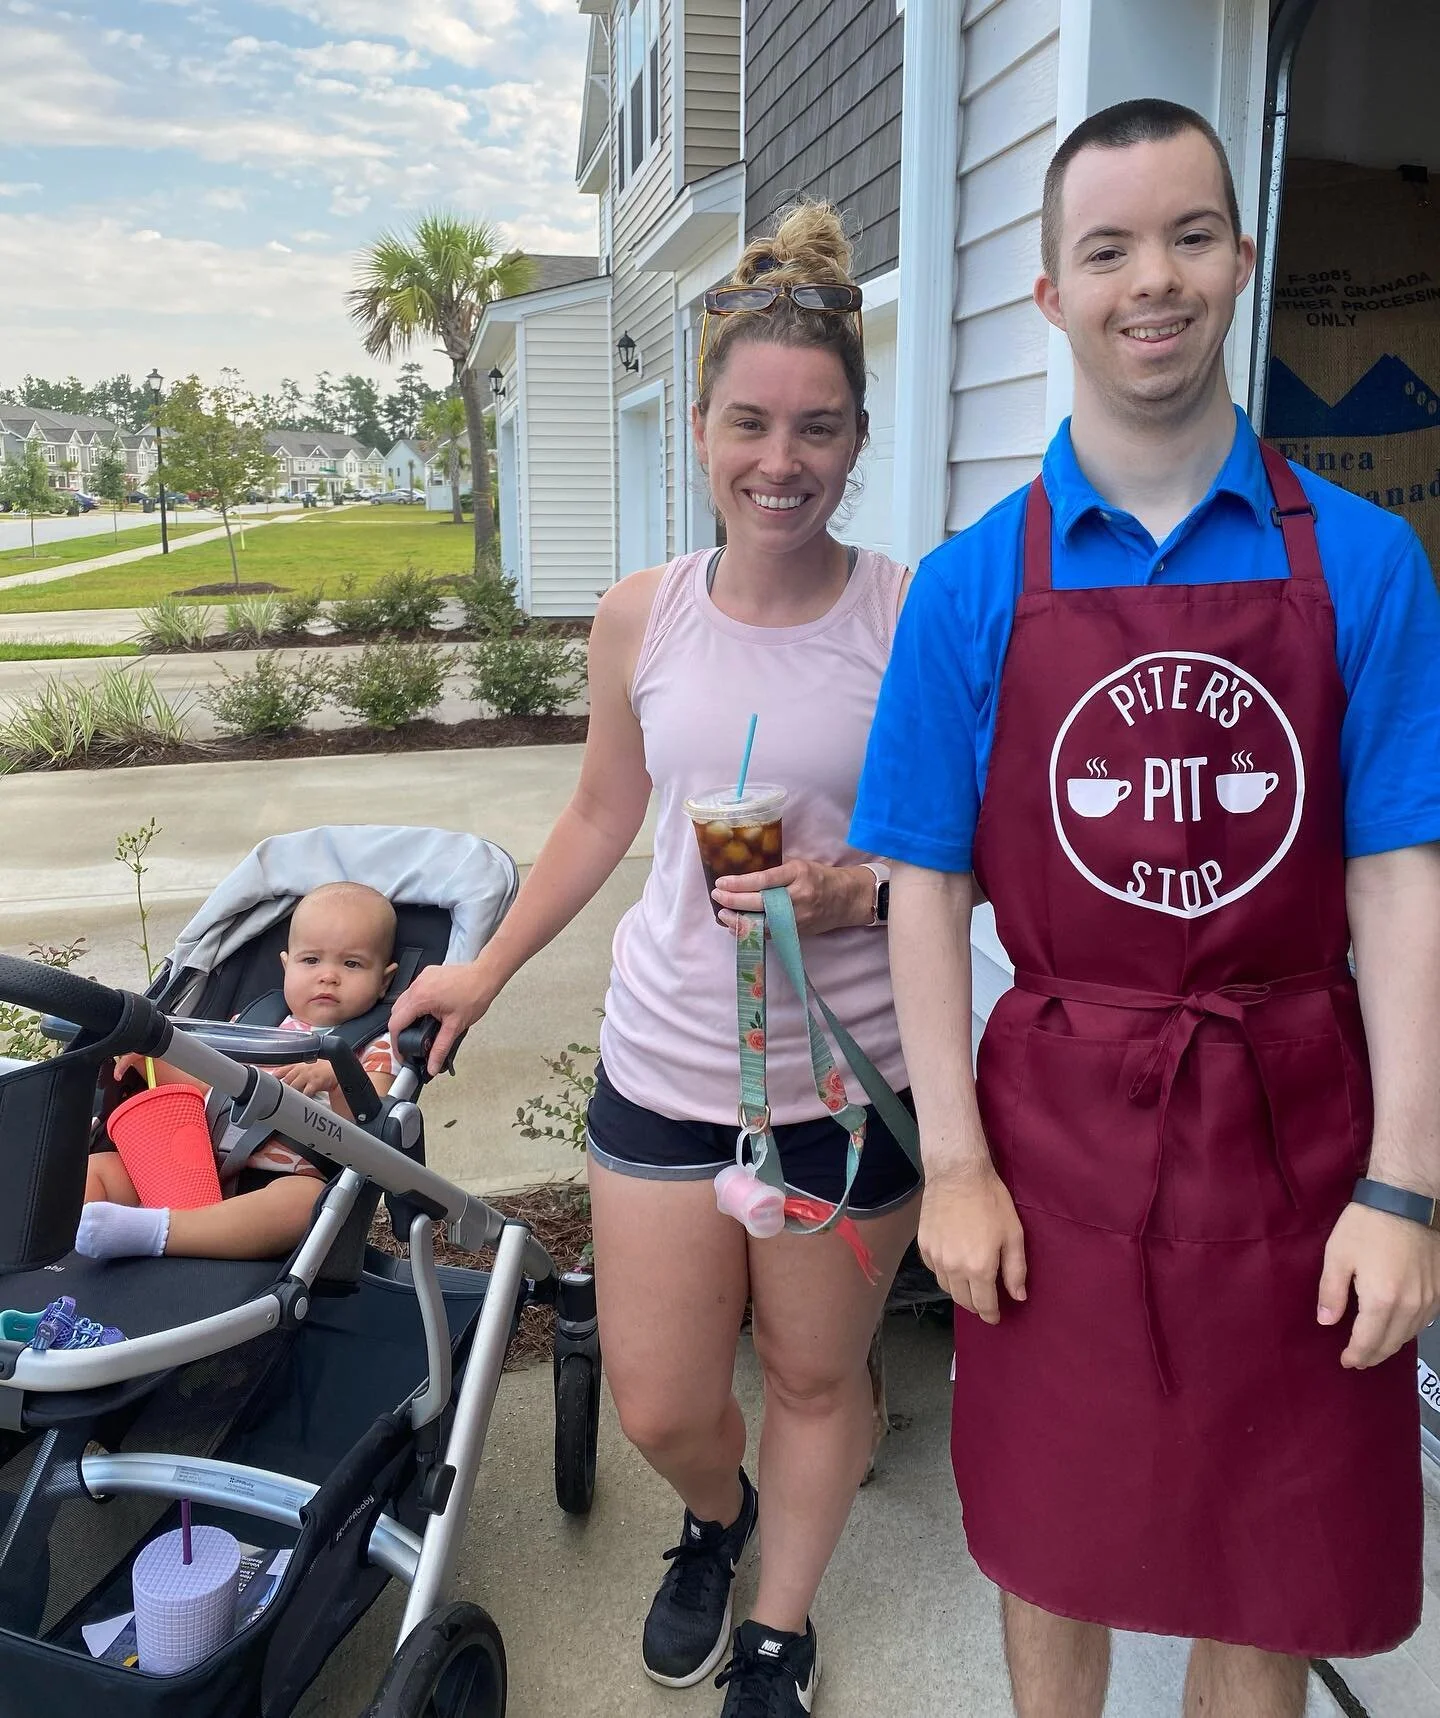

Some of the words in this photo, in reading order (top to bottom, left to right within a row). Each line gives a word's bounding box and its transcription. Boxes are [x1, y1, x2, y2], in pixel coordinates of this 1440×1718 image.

[1275, 283, 1338, 298] NUEVA
[1344, 271, 1433, 298] GRANADA
[1275, 298, 1333, 310] THER
[1306, 312, 1357, 327] ONLY
[1280, 443, 1374, 471] Finca
[1107, 664, 1253, 729] PETER'S
[1143, 756, 1208, 823] PIT
[1126, 859, 1223, 911] STOP
[303, 1106, 343, 1143] VISTA
[761, 1639, 783, 1654] NIKE
